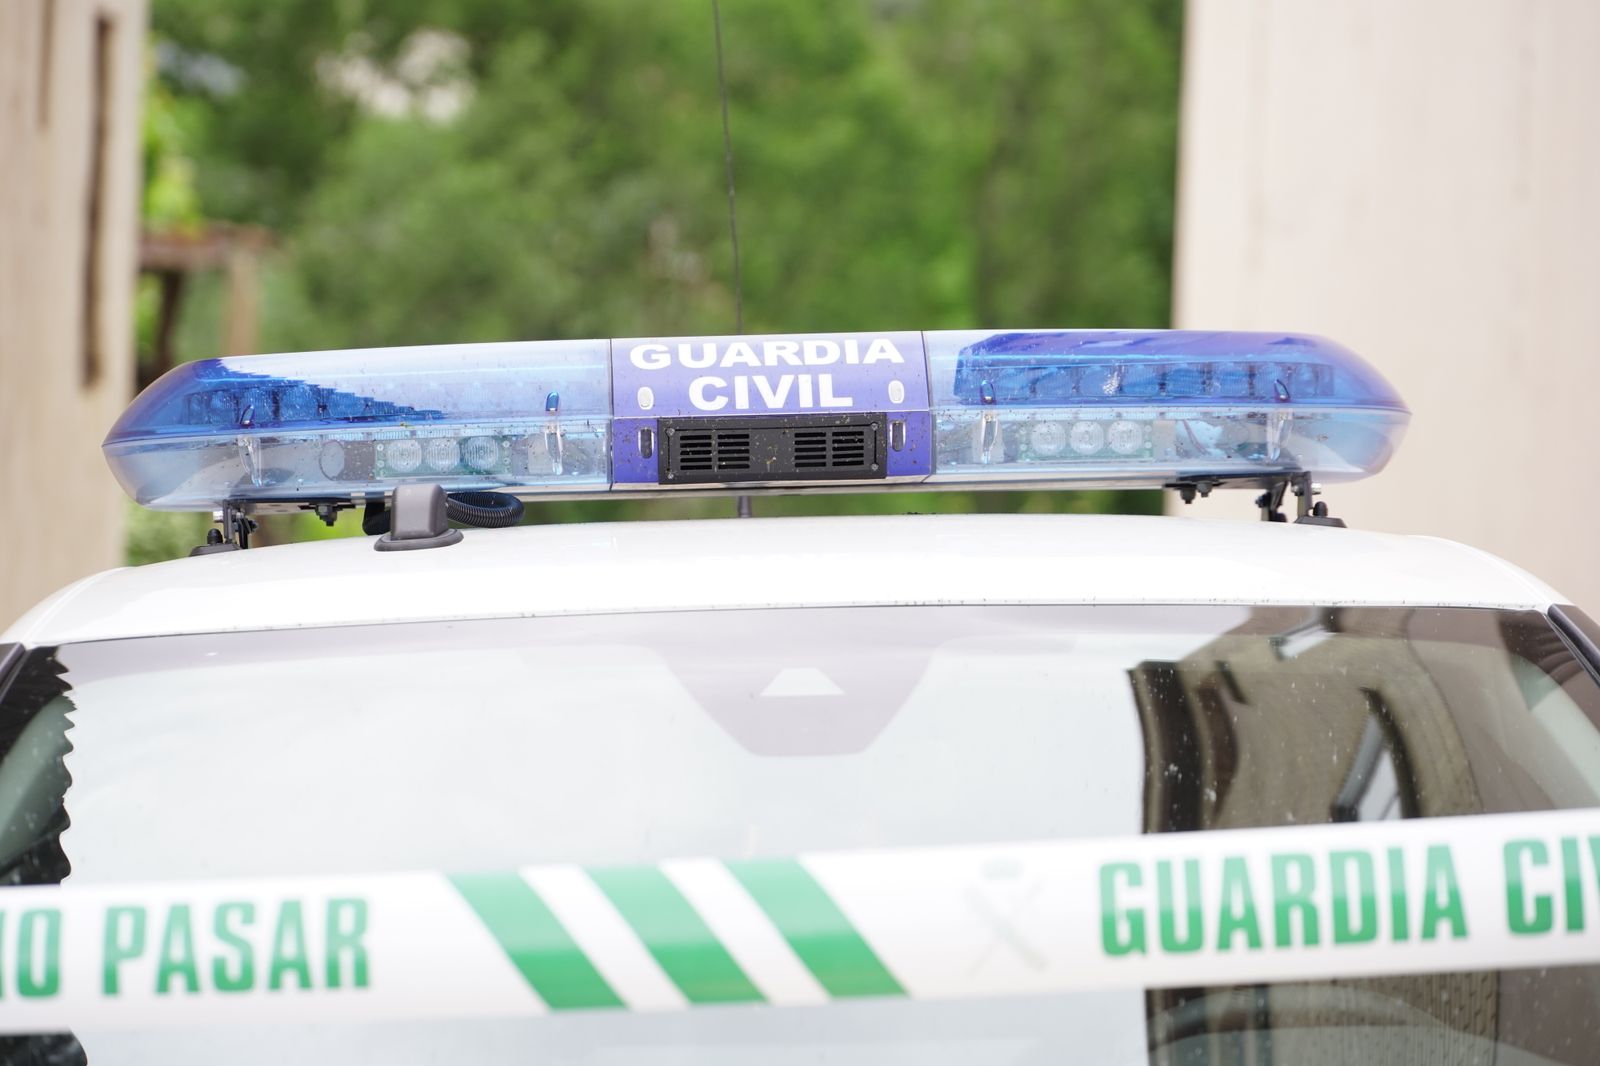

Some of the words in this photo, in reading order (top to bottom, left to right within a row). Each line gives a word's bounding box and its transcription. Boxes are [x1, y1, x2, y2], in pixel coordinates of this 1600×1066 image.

[630, 338, 905, 370] GUARDIA
[689, 373, 853, 411] CIVIL
[1099, 843, 1469, 957] GUARDIA
[1503, 834, 1600, 936] CI
[0, 907, 62, 998] O
[102, 898, 370, 996] PASAR
